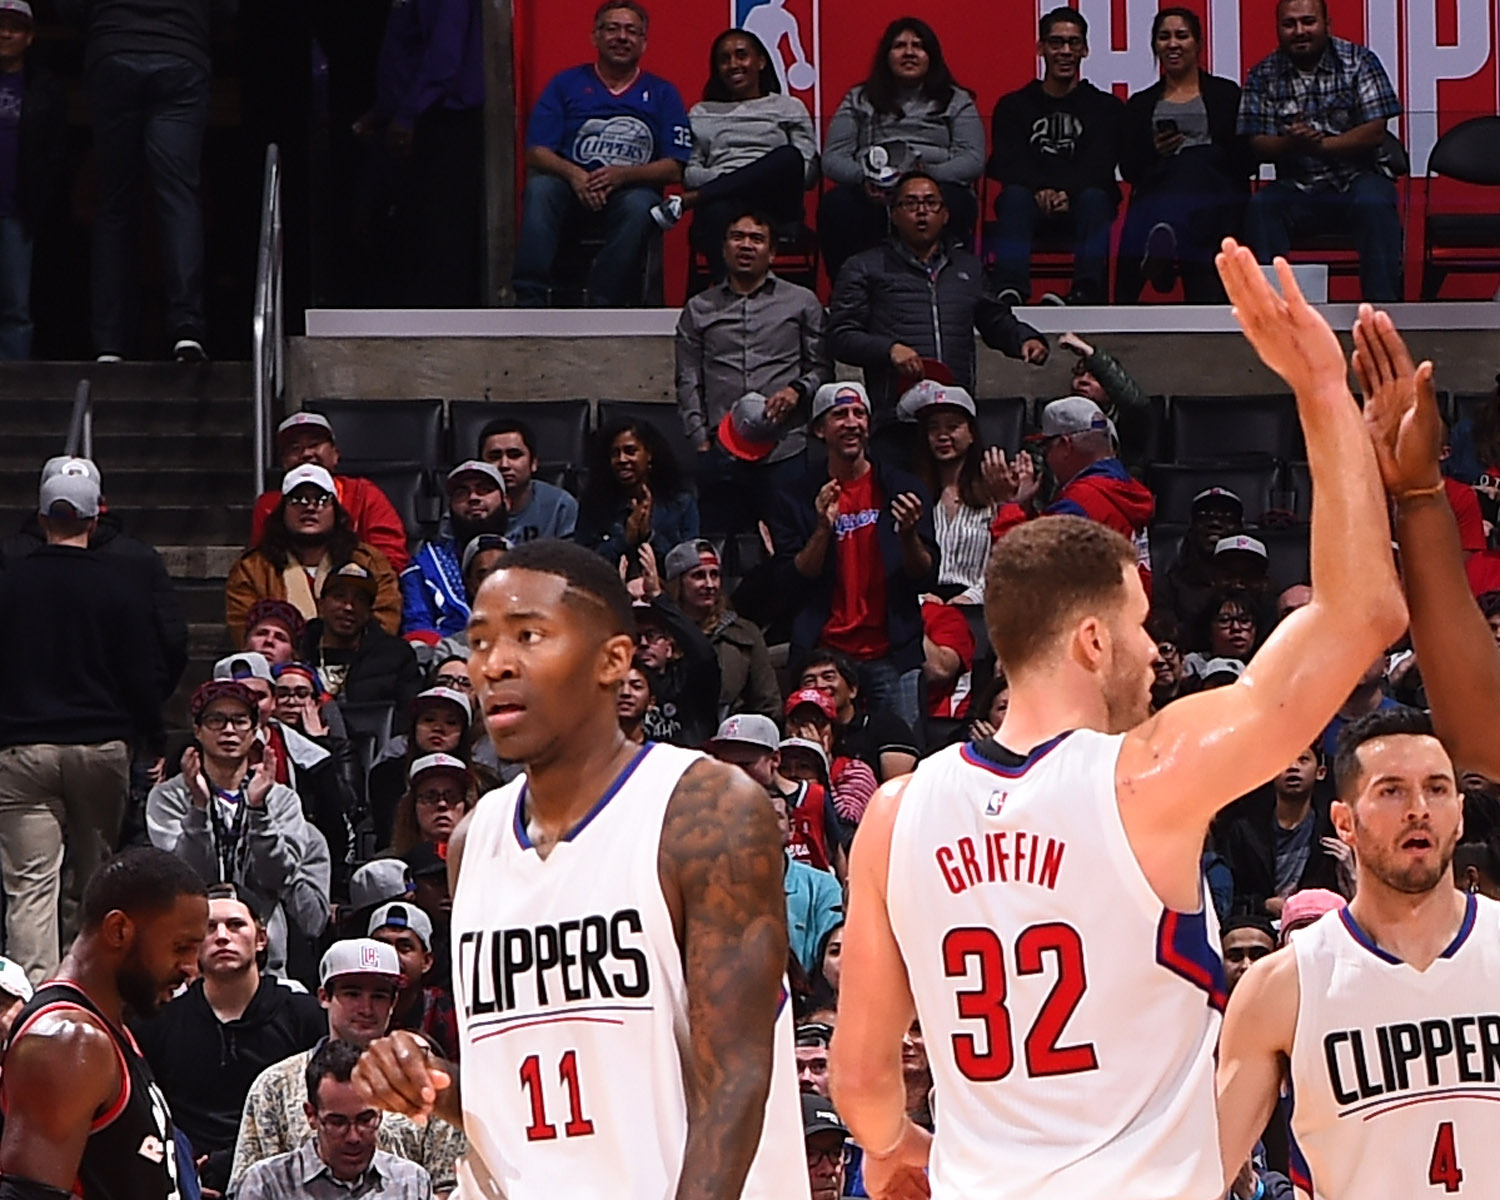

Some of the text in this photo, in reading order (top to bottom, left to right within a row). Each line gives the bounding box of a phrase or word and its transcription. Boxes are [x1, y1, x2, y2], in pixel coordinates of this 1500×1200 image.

[935, 832, 1066, 894] GRIFFIN
[459, 908, 651, 1020] CLIPPERS
[942, 921, 1100, 1082] 32
[519, 1050, 595, 1142] 11
[1429, 1121, 1464, 1193] 4
